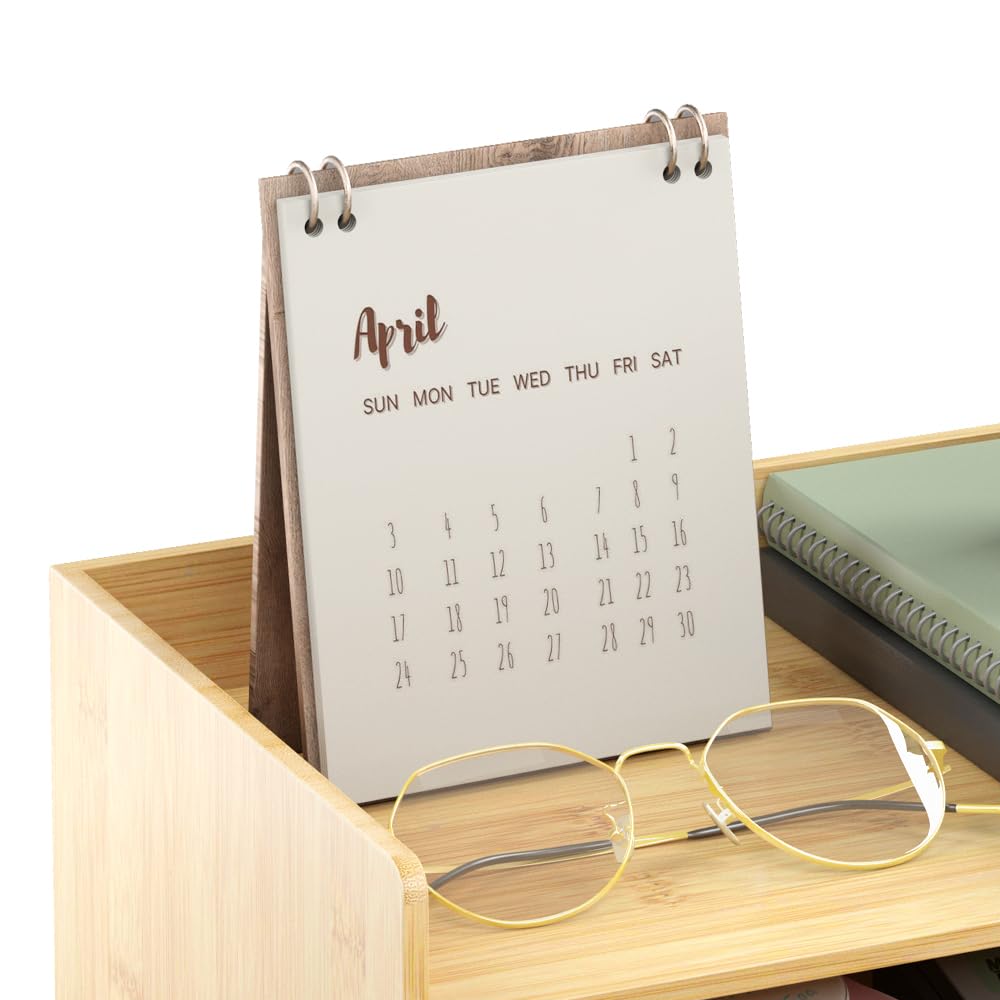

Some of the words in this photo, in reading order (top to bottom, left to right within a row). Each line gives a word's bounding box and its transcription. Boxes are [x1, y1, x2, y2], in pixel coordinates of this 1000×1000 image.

[353, 294, 448, 371] April
[363, 394, 399, 415] SUN
[413, 385, 454, 407] MON
[467, 378, 500, 398] TUE
[513, 370, 551, 391] WED
[564, 361, 599, 382] THU
[613, 356, 637, 375] FRI
[651, 348, 682, 369] SAT
[628, 435, 639, 461] 1
[668, 428, 677, 455] 2
[387, 522, 397, 548] 3
[444, 512, 452, 539] 4
[490, 504, 500, 531] 5
[540, 496, 548, 523] 6
[594, 487, 601, 514] 7
[632, 480, 641, 508] 8
[671, 473, 680, 500] 9
[386, 568, 404, 596] 10
[442, 559, 460, 587] 11
[489, 550, 506, 578] 12
[537, 542, 555, 570] 13
[593, 532, 610, 560] 14
[631, 525, 648, 553] 15
[671, 519, 688, 547] 16
[390, 614, 405, 642] 17
[445, 603, 463, 632] 18
[493, 595, 509, 624] 19
[543, 588, 560, 616] 20
[597, 578, 615, 606] 21
[635, 571, 652, 600] 22
[674, 565, 692, 592] 23
[395, 661, 412, 689] 24
[450, 650, 468, 679] 25
[497, 642, 515, 671] 26
[546, 633, 561, 662] 27
[601, 623, 619, 652] 28
[639, 616, 655, 645] 29
[676, 611, 696, 638] 30
